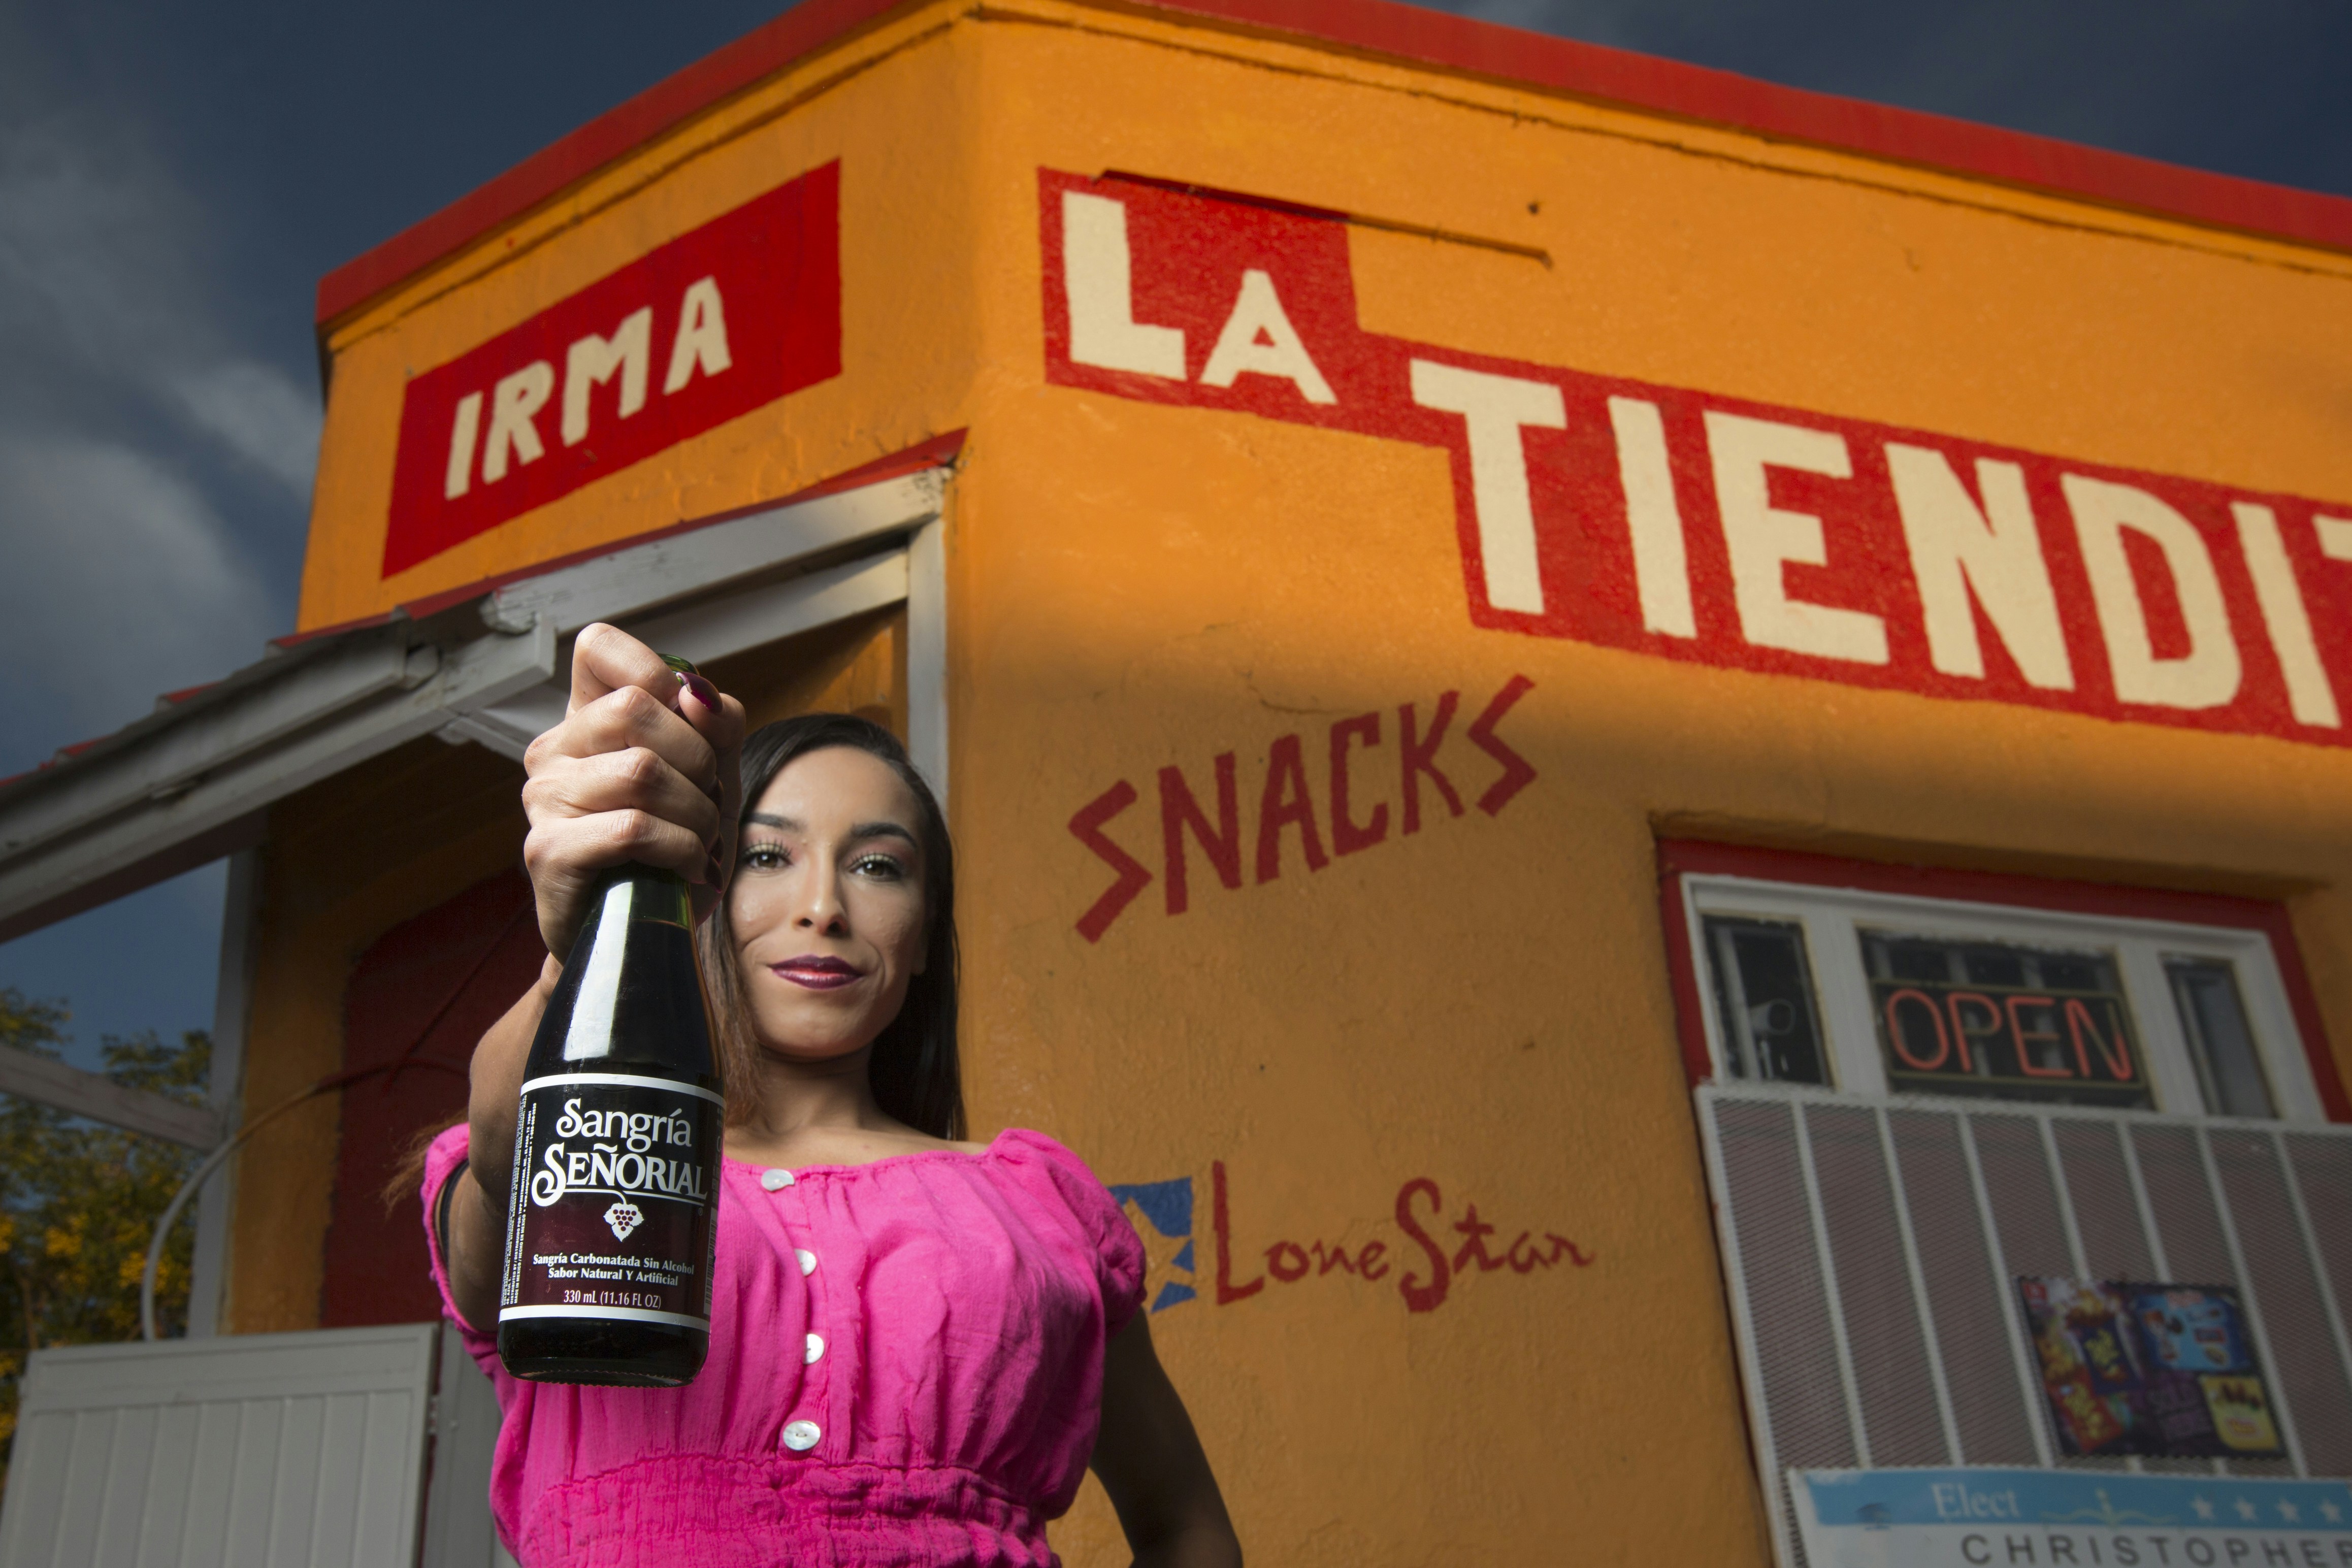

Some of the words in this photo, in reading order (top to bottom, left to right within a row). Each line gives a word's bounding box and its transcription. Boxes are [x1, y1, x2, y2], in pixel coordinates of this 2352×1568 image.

[1062, 190, 1338, 405] LA
[445, 275, 732, 501] IRMA
[1067, 673, 1537, 944] SNACKS
[1886, 988, 2133, 1080] OPEN
[557, 1097, 692, 1153] Sangría
[531, 1142, 708, 1206] SEÑORIAL
[533, 1253, 567, 1266] Sangría
[570, 1253, 640, 1266] Carbonatada
[643, 1258, 659, 1268] Sin
[662, 1260, 694, 1275] Alcohol
[548, 1267, 578, 1279] Sabor
[580, 1268, 622, 1280] Natural
[626, 1270, 633, 1281] Y
[636, 1272, 678, 1286] Artificial
[564, 1290, 581, 1303] 330
[583, 1291, 597, 1303] mL
[600, 1291, 630, 1305] (11.16
[633, 1293, 642, 1306] FL
[645, 1294, 661, 1310] OZ)
[1931, 1483, 2021, 1519] Elect
